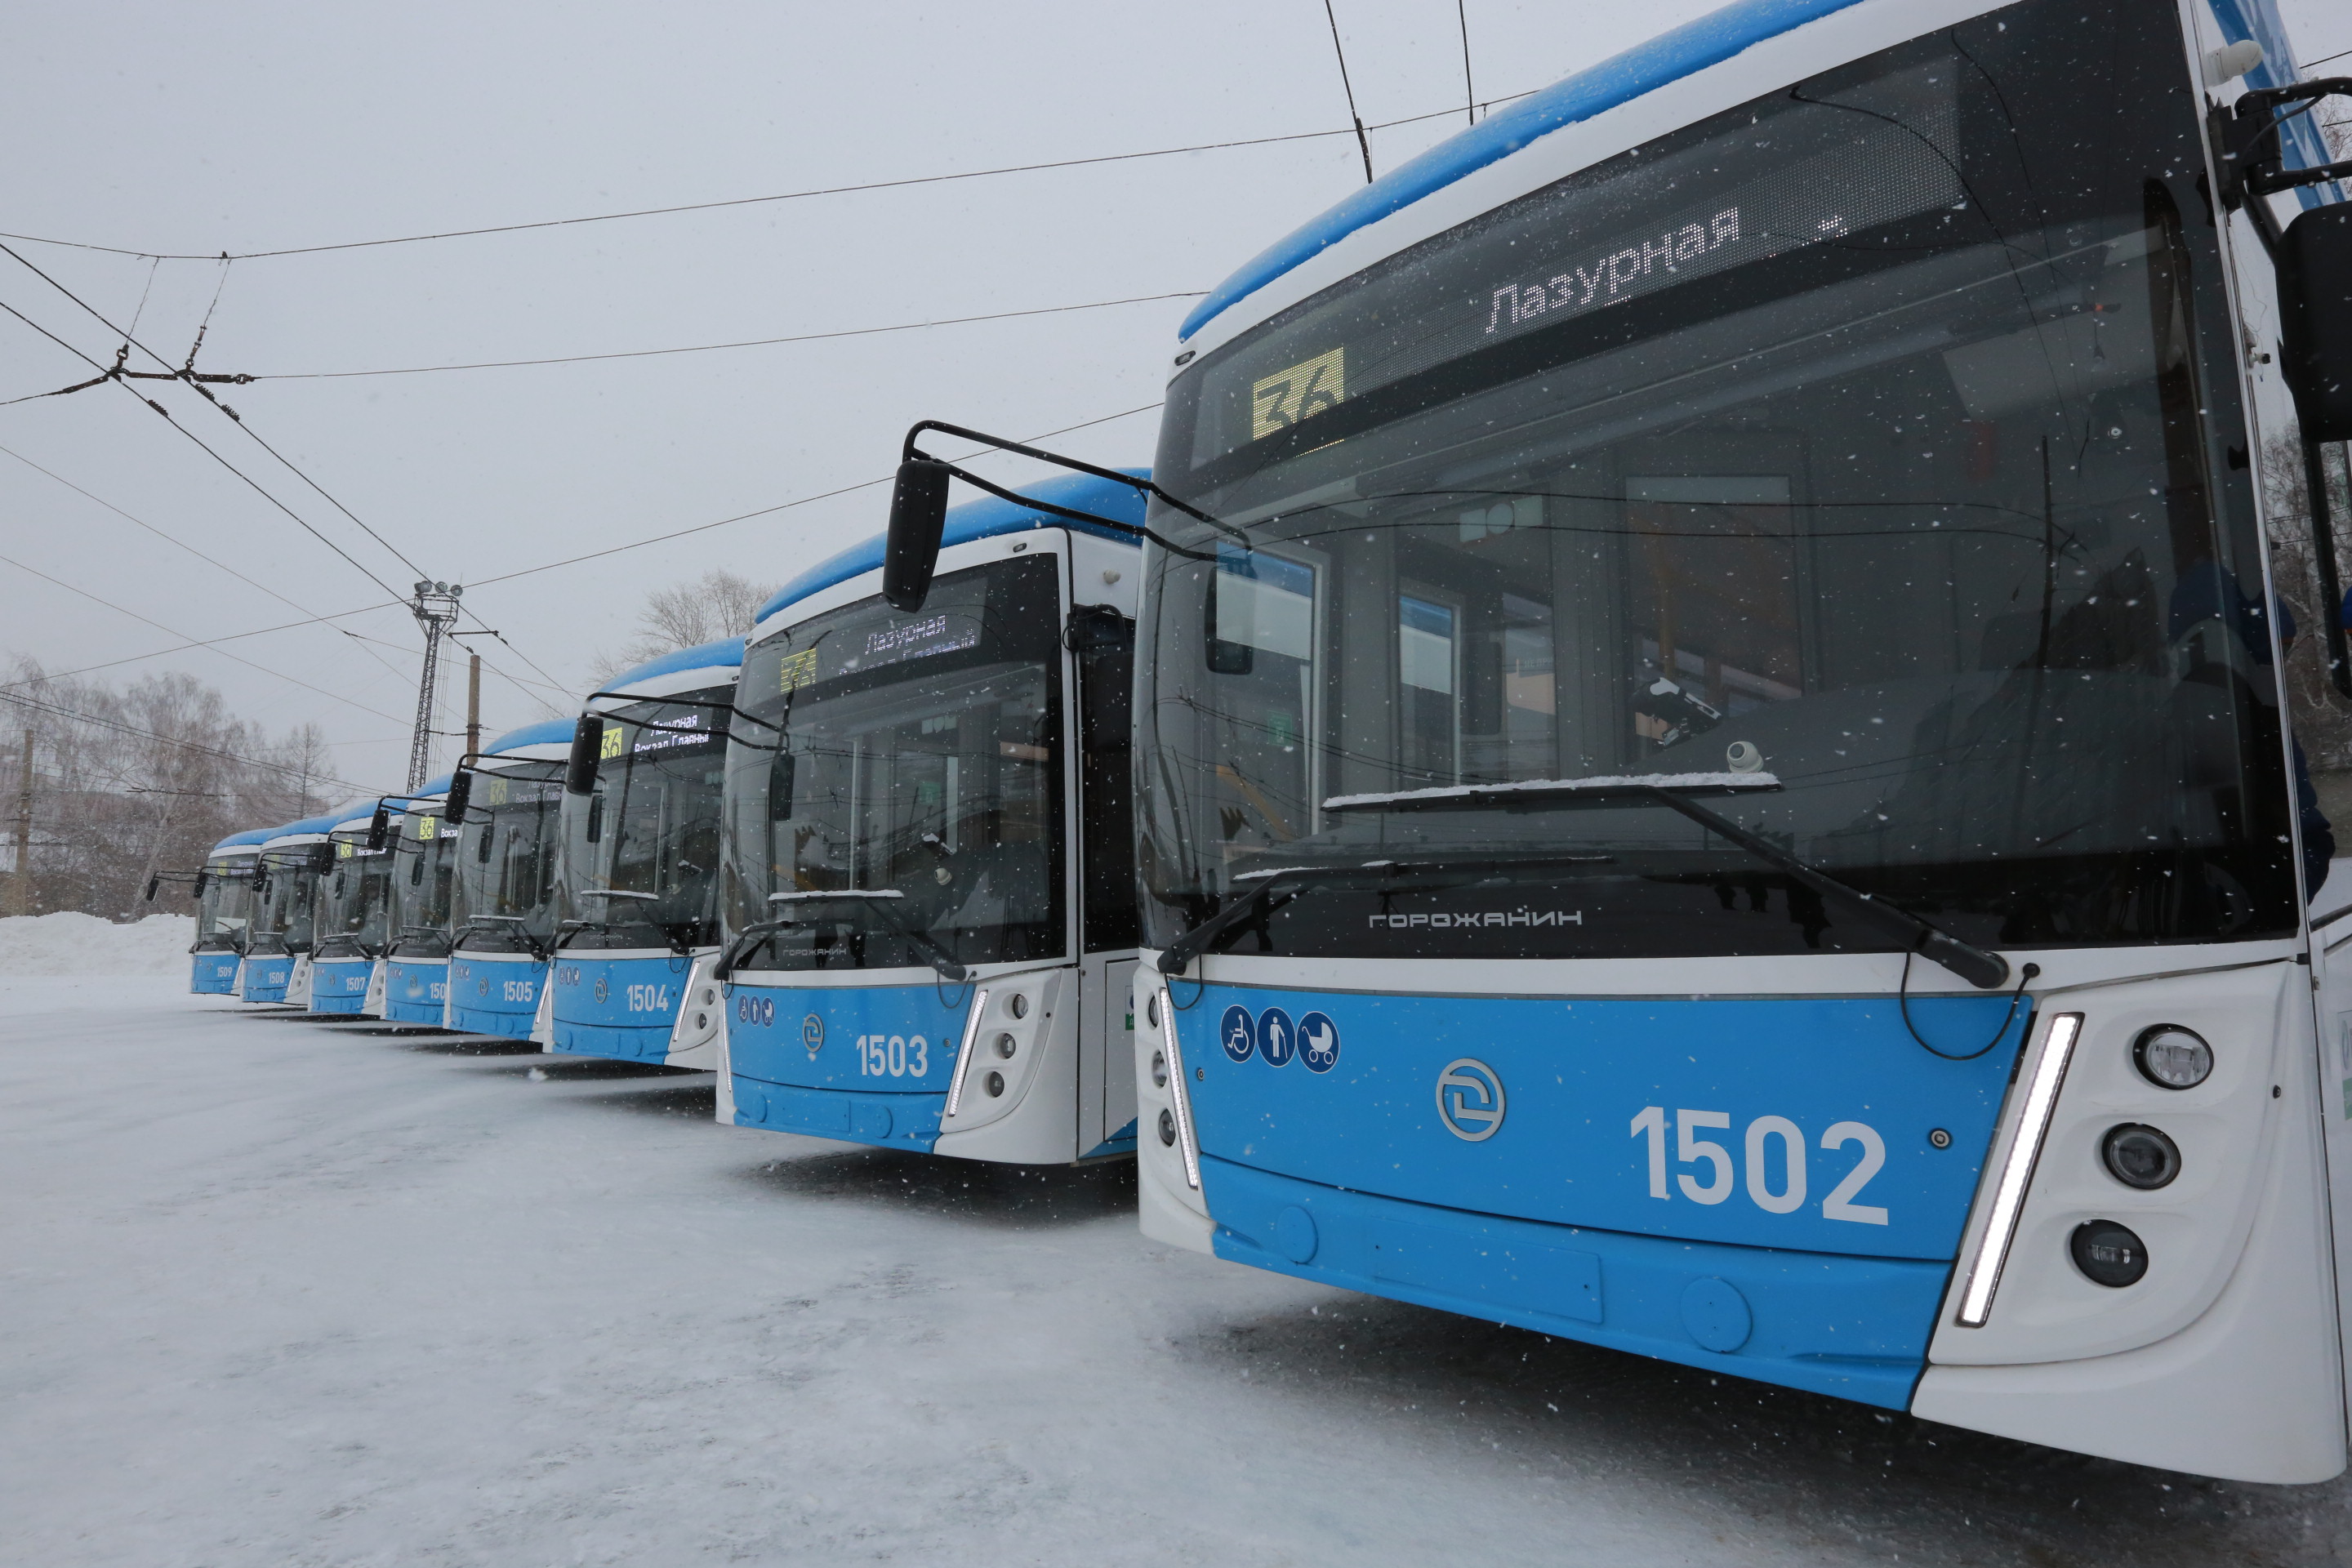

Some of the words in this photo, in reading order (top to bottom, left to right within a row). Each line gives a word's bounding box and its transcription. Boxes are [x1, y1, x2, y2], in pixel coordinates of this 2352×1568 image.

[1485, 206, 1740, 334] Лазурная
[864, 615, 946, 655] Лазурная
[603, 732, 620, 758] 36
[490, 782, 506, 804] 36
[515, 793, 541, 804] Вокзал
[420, 819, 433, 838] 36
[341, 840, 352, 857] 36
[1369, 911, 1583, 928] ГОРОЖАНИН
[782, 947, 847, 956] ГОРОЖАНИН
[217, 967, 233, 978] 1509
[269, 972, 285, 985] 1508
[346, 978, 365, 991] 1507
[503, 981, 533, 1002] 1505
[626, 984, 669, 1012] 1504
[856, 1035, 929, 1077] 1503
[1631, 1106, 1888, 1226] 1502
